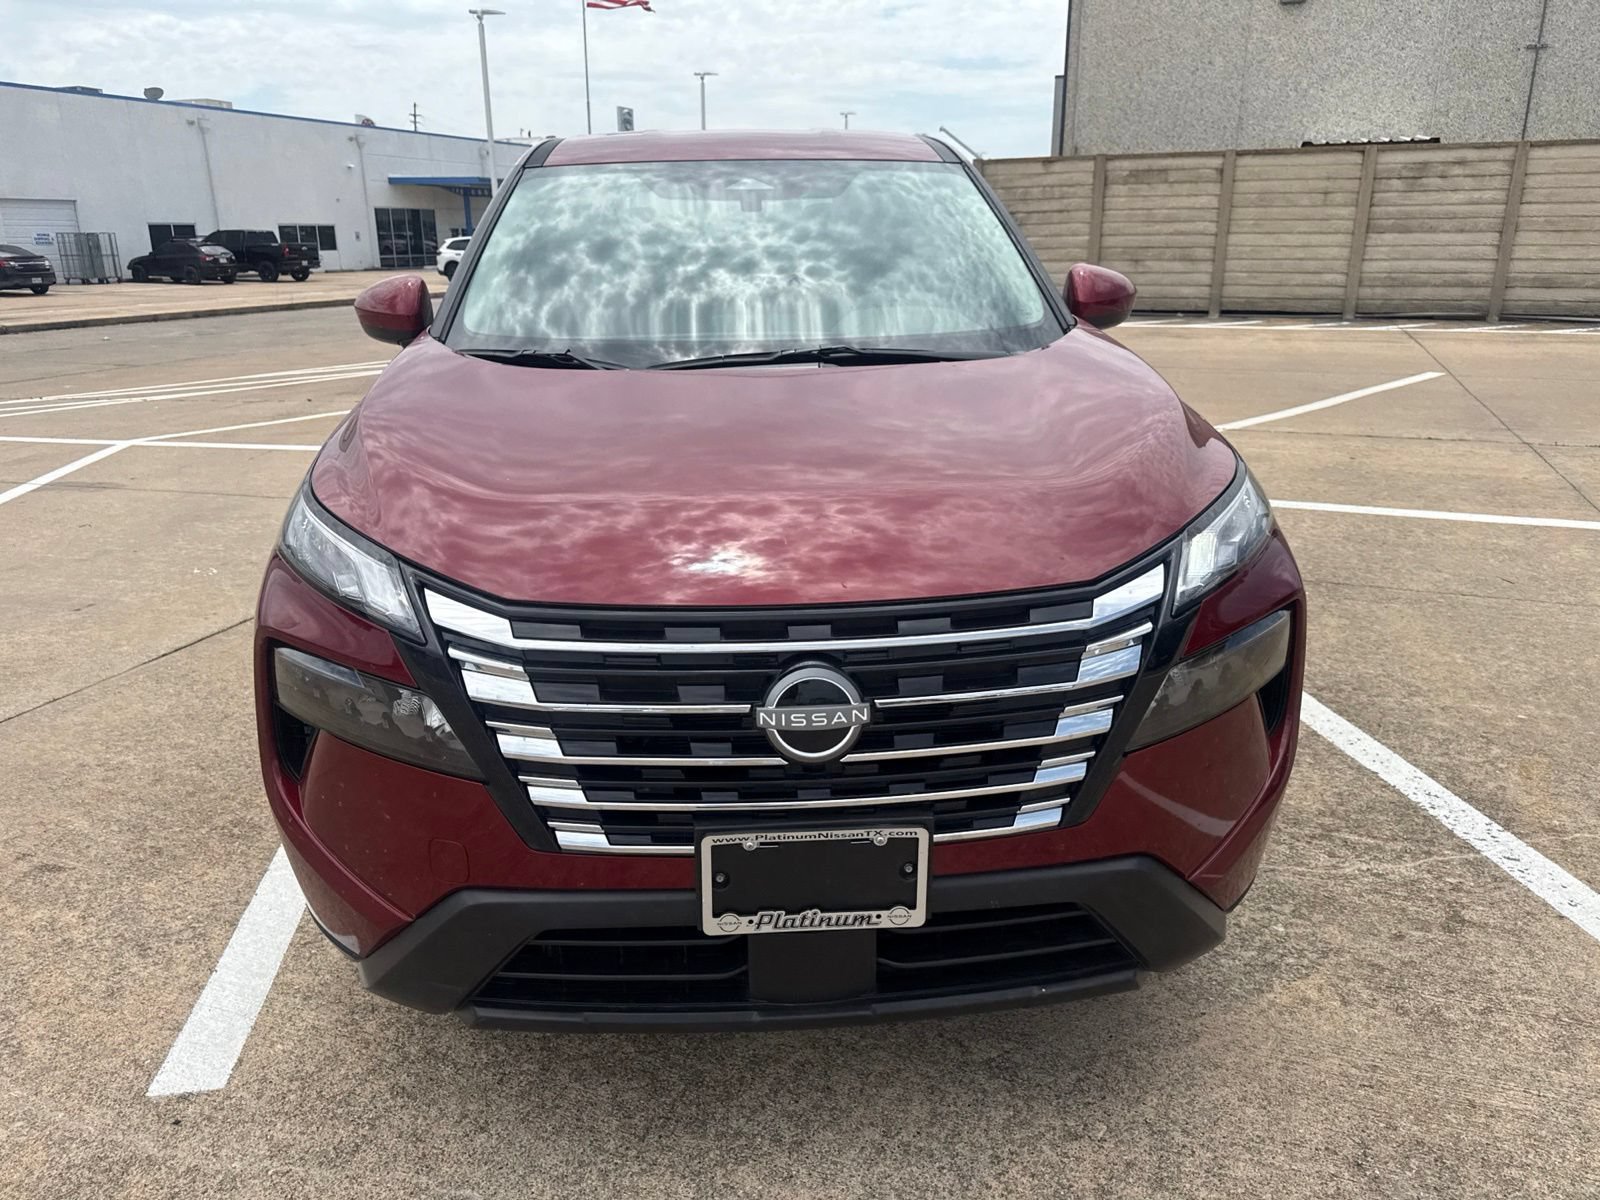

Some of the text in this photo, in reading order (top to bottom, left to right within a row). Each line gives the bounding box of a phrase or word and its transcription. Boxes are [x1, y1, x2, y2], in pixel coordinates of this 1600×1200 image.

[760, 708, 868, 726] NISSAN
[712, 830, 918, 843] www.PlatinumNissanTX.com
[755, 910, 882, 930] Platinum
